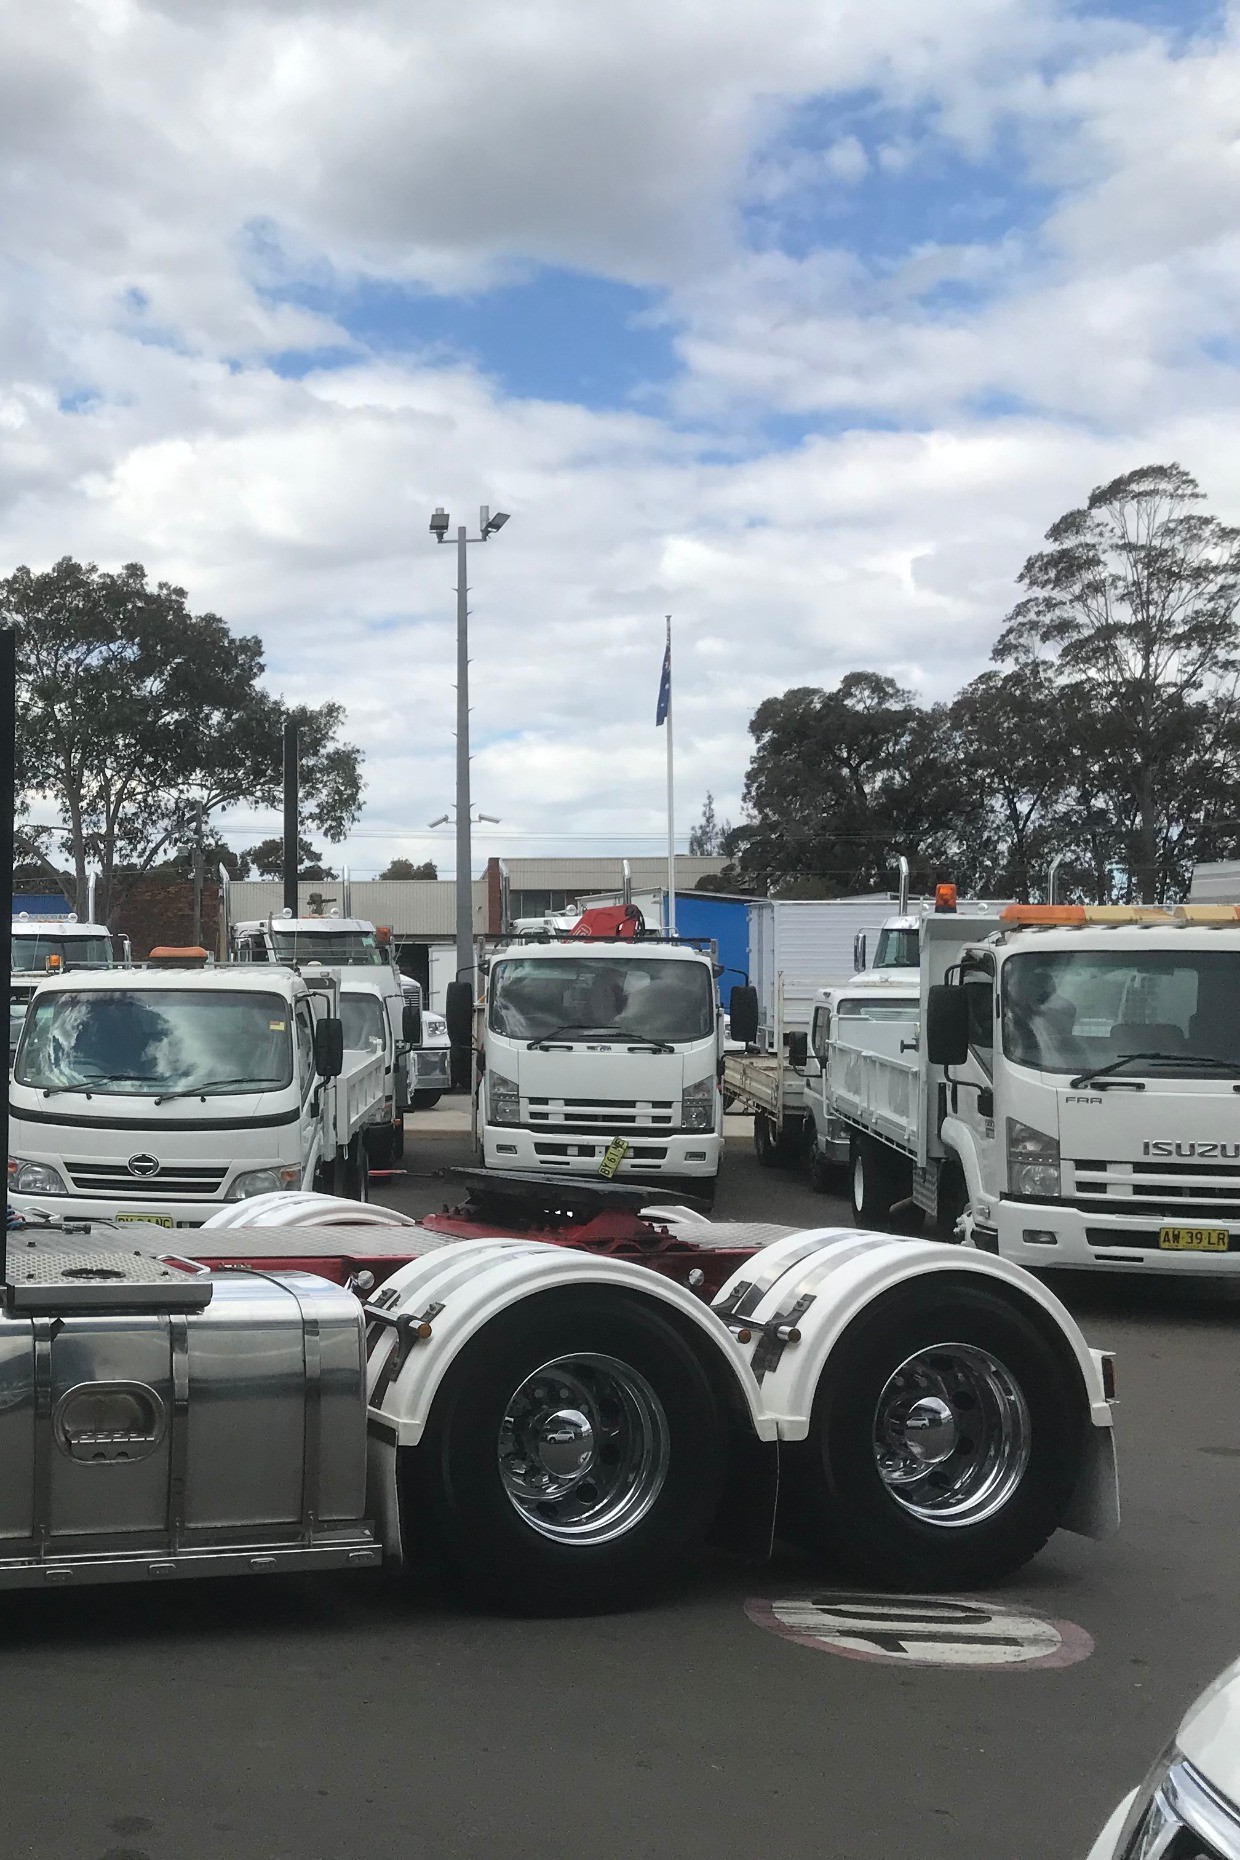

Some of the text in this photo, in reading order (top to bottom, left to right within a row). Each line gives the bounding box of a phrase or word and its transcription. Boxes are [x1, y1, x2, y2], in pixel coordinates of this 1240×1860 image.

[1143, 1140, 1240, 1159] ISUZU
[1185, 1231, 1203, 1245] 39
[1207, 1232, 1226, 1246] LR
